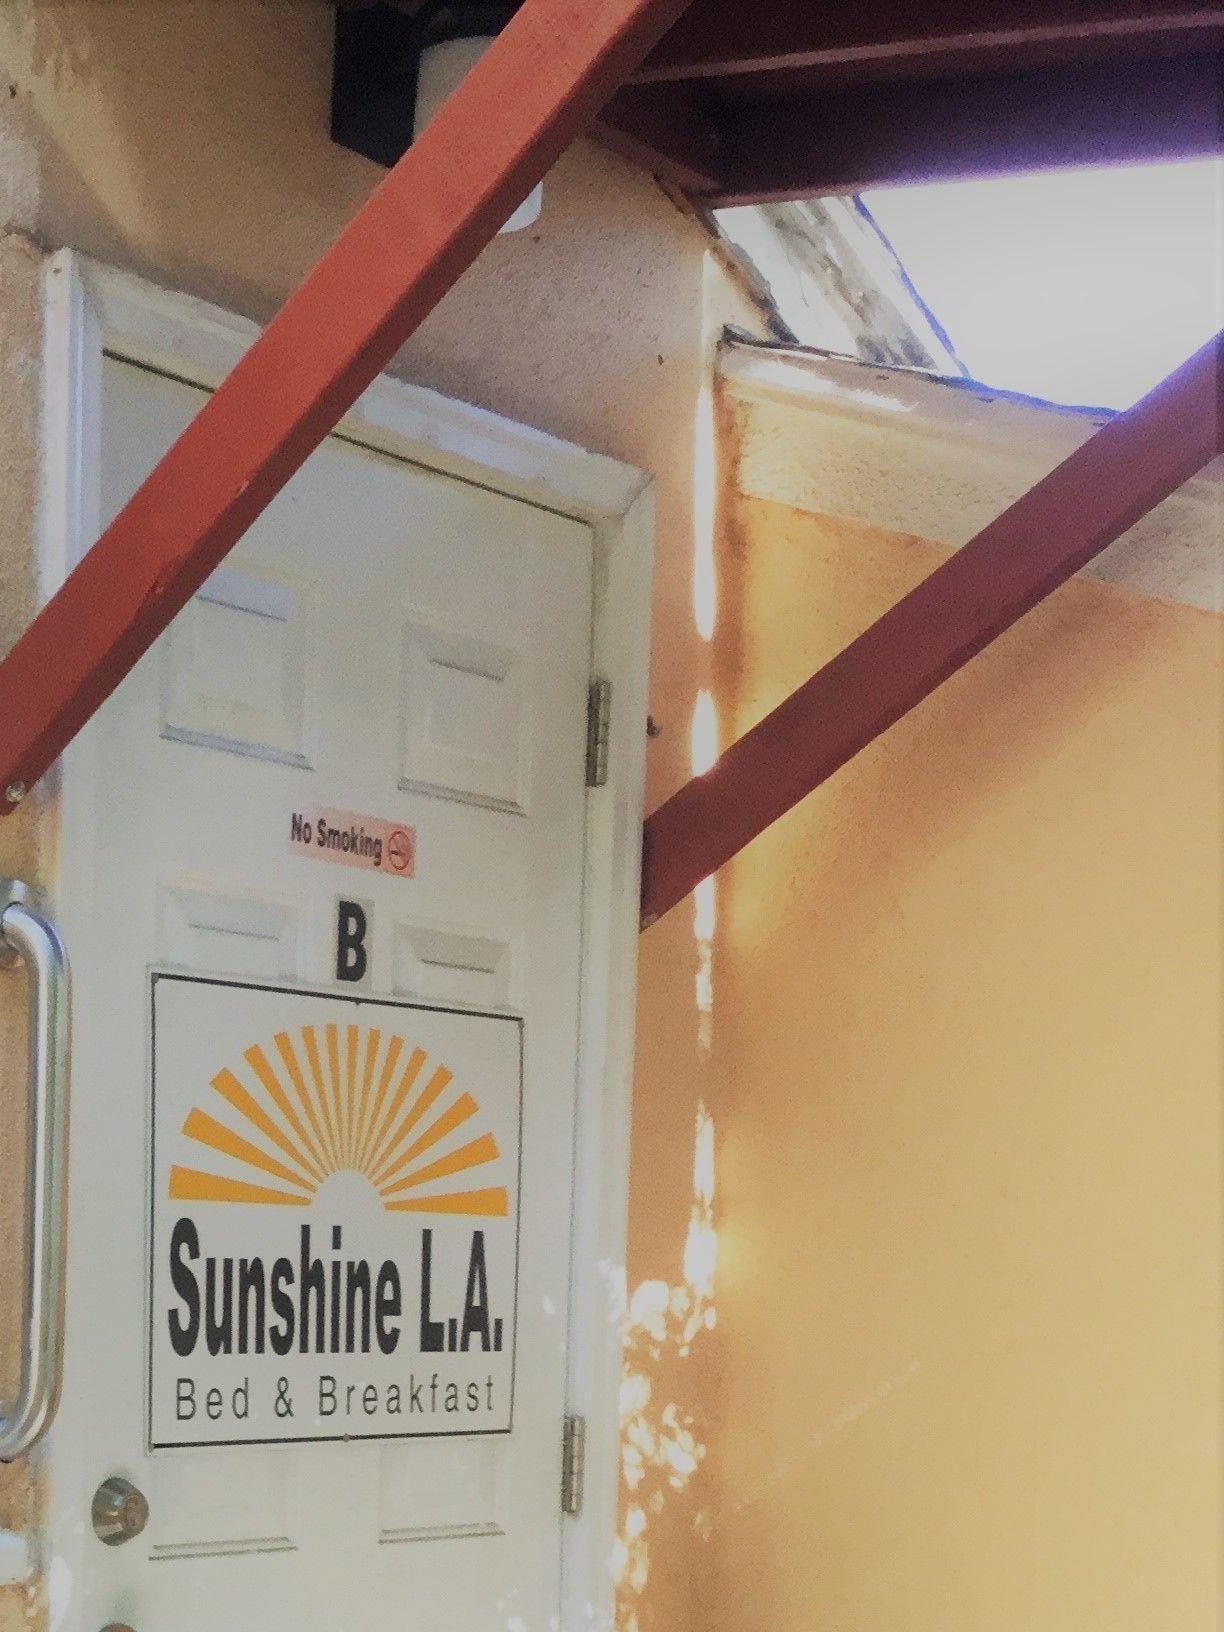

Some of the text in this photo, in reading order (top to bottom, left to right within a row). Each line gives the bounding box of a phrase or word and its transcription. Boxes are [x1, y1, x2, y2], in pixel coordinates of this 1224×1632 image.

[291, 813, 382, 867] No Smoking
[337, 900, 367, 982] B
[168, 1217, 503, 1357] Sunshine L.A.
[176, 1373, 494, 1420] Bed & Breakfast
